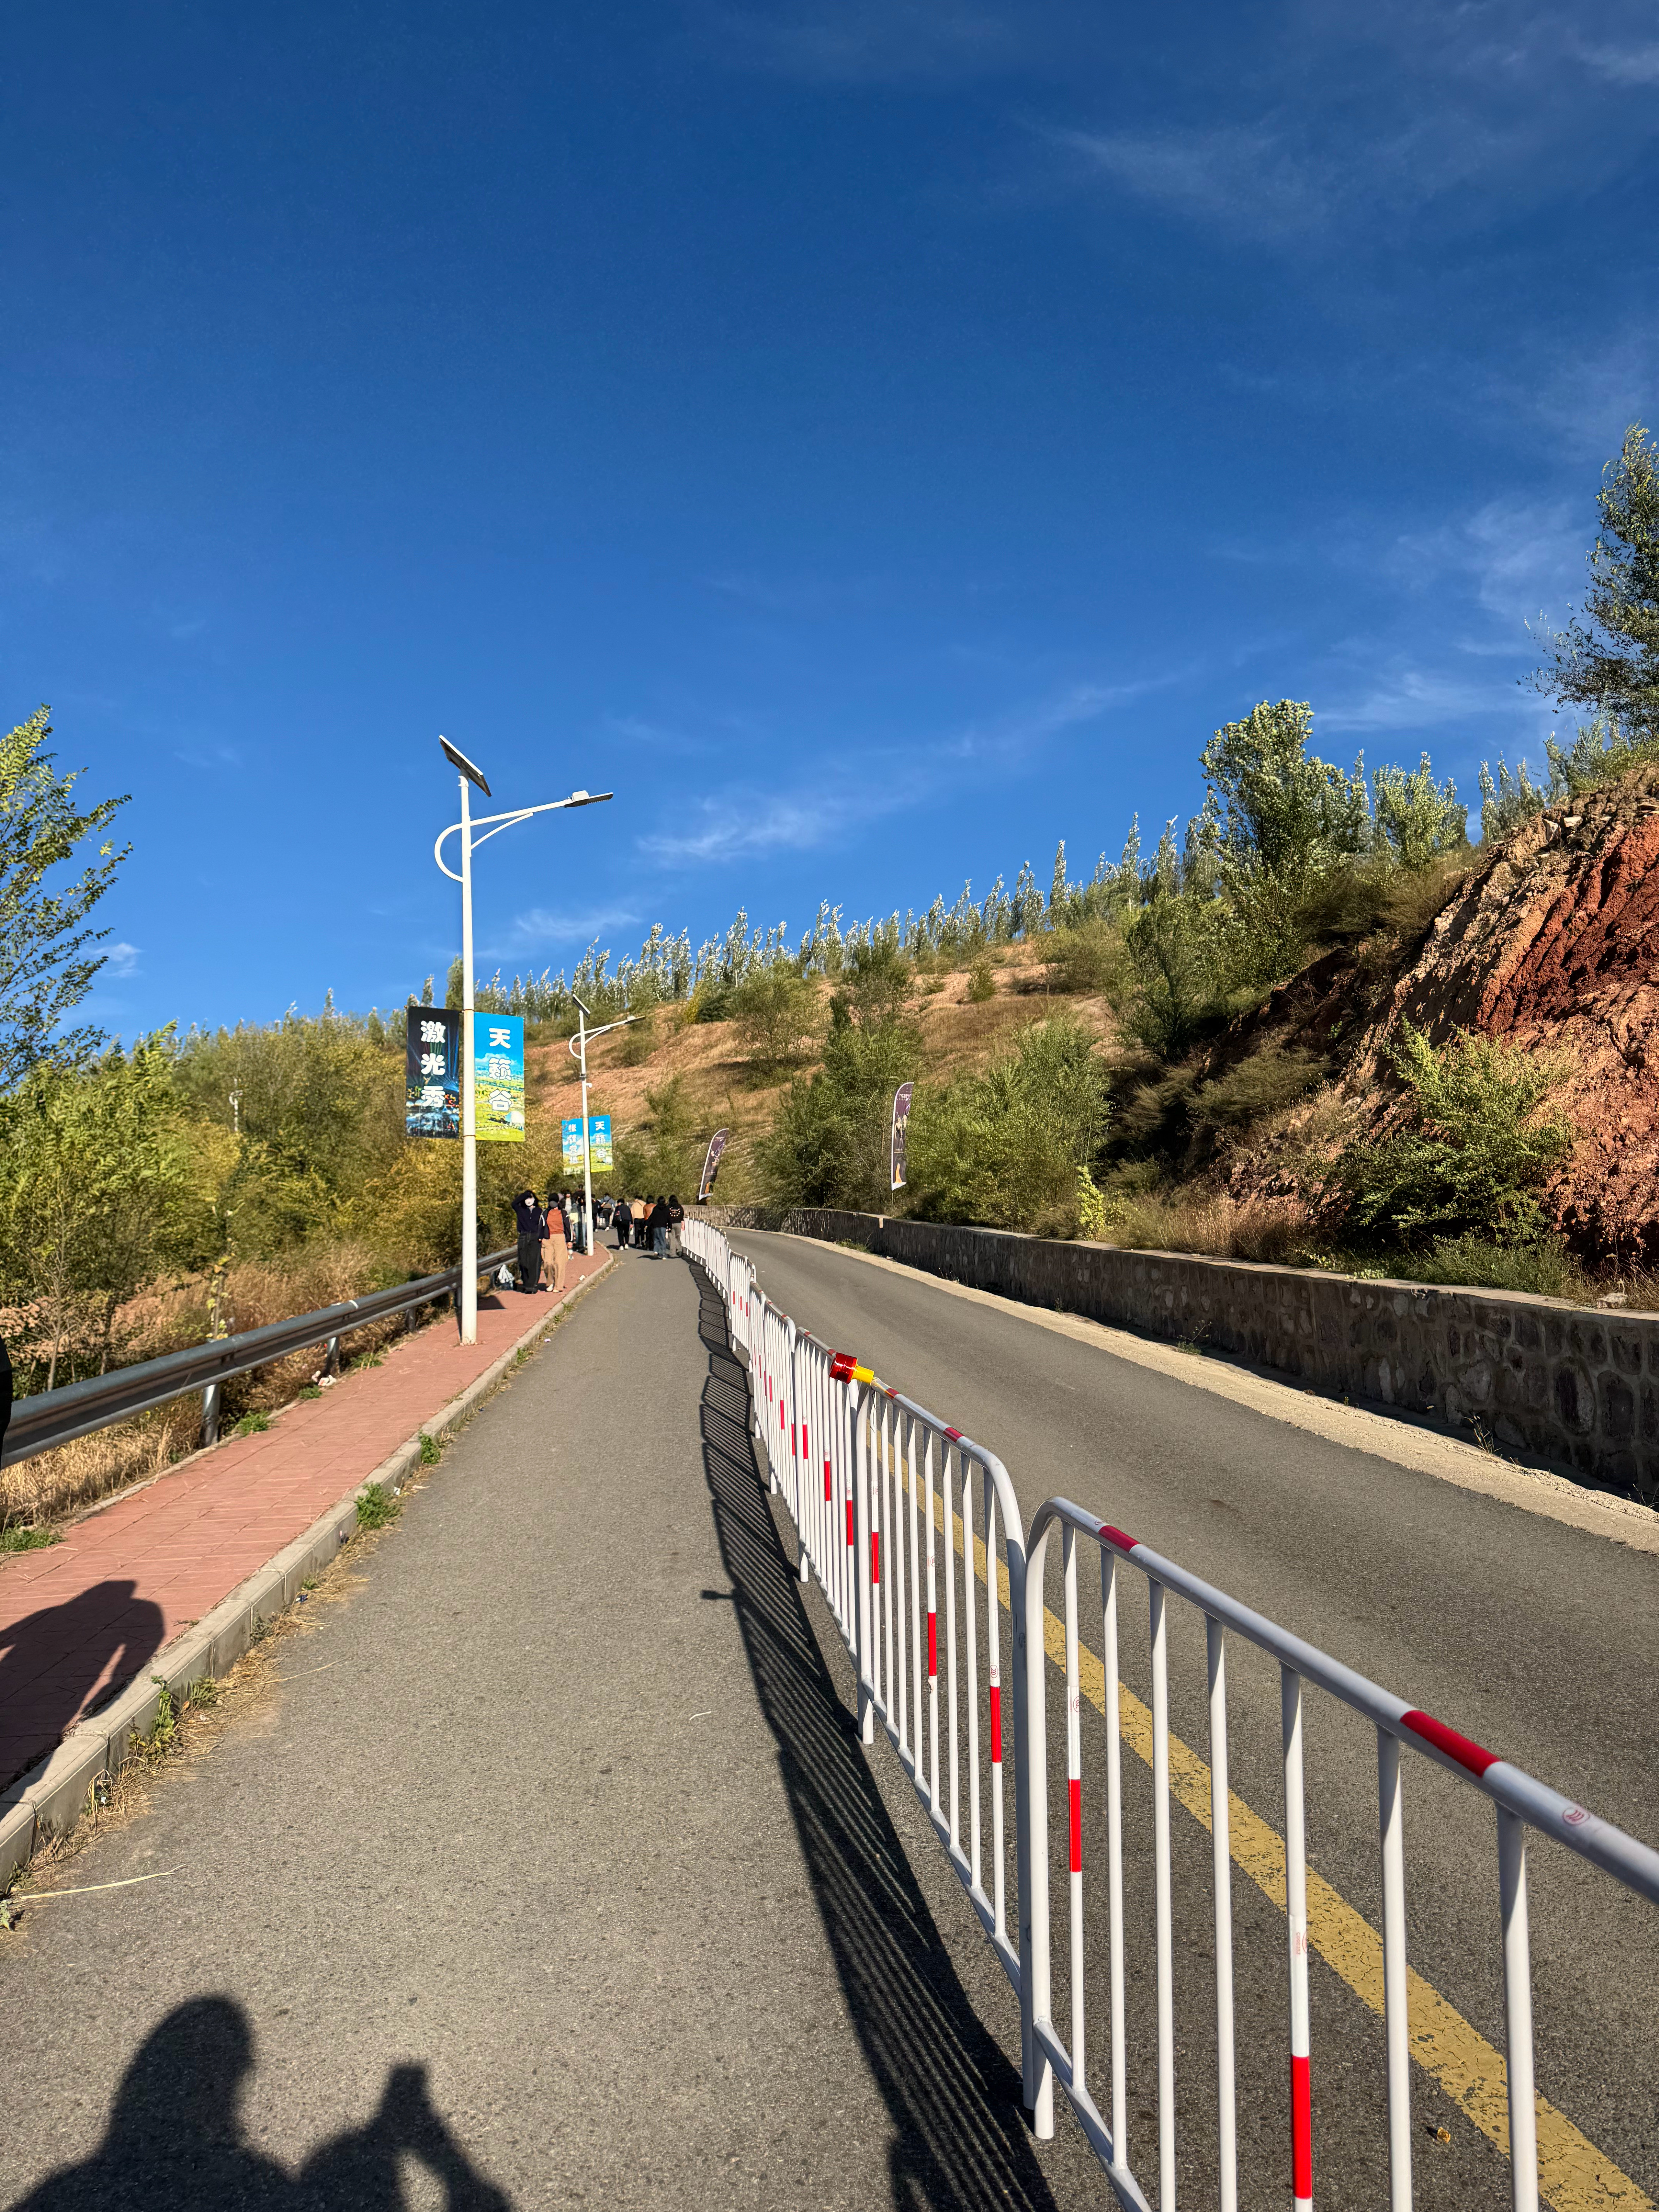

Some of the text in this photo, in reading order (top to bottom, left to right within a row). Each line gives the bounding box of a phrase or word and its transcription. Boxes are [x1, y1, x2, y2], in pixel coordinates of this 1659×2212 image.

[421, 1020, 446, 1108] 激光秀
[489, 1027, 512, 1111] 天籁谷
[595, 1121, 606, 1158] 天籁谷
